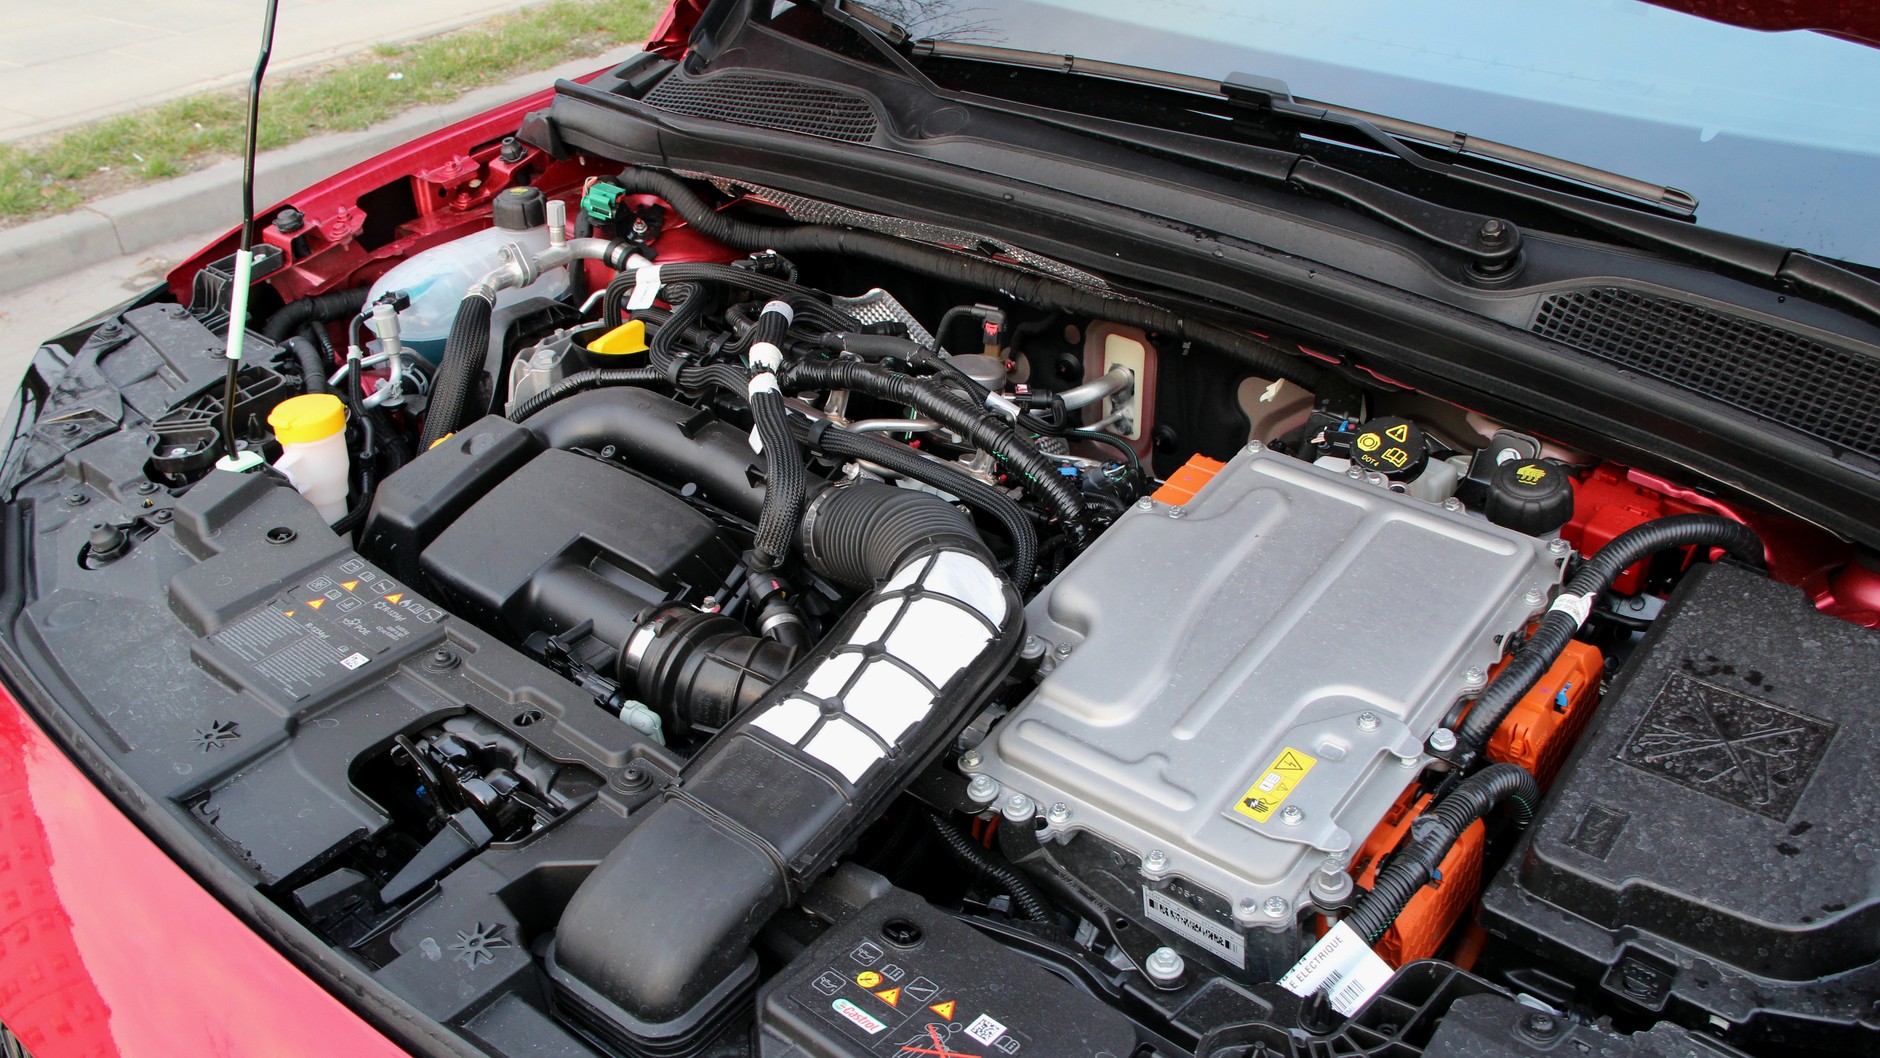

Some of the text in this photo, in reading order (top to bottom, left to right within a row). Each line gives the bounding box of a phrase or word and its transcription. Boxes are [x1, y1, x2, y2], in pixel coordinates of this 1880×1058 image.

[1361, 454, 1376, 464] DOT
[354, 624, 371, 636] POE
[1296, 935, 1344, 983] ELECTRIQUE
[843, 1006, 880, 1031] Castrol
